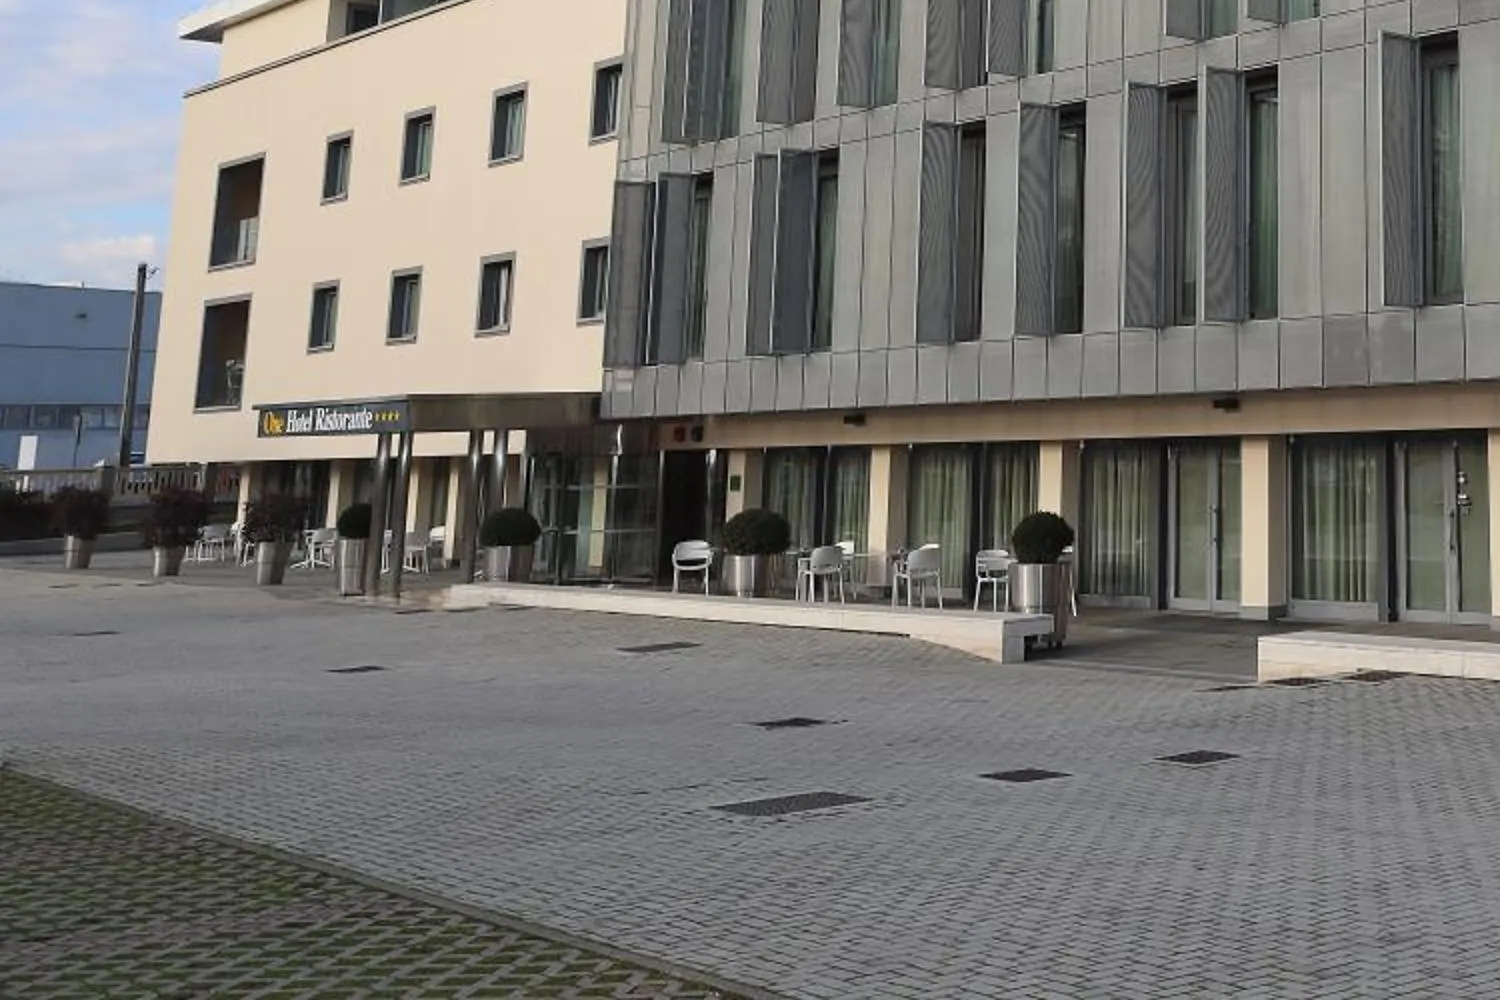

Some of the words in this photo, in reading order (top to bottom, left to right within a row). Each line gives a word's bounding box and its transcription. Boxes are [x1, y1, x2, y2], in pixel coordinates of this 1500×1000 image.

[263, 411, 284, 434] One
[286, 409, 312, 432] Hotel
[315, 407, 373, 430] Ristorante
